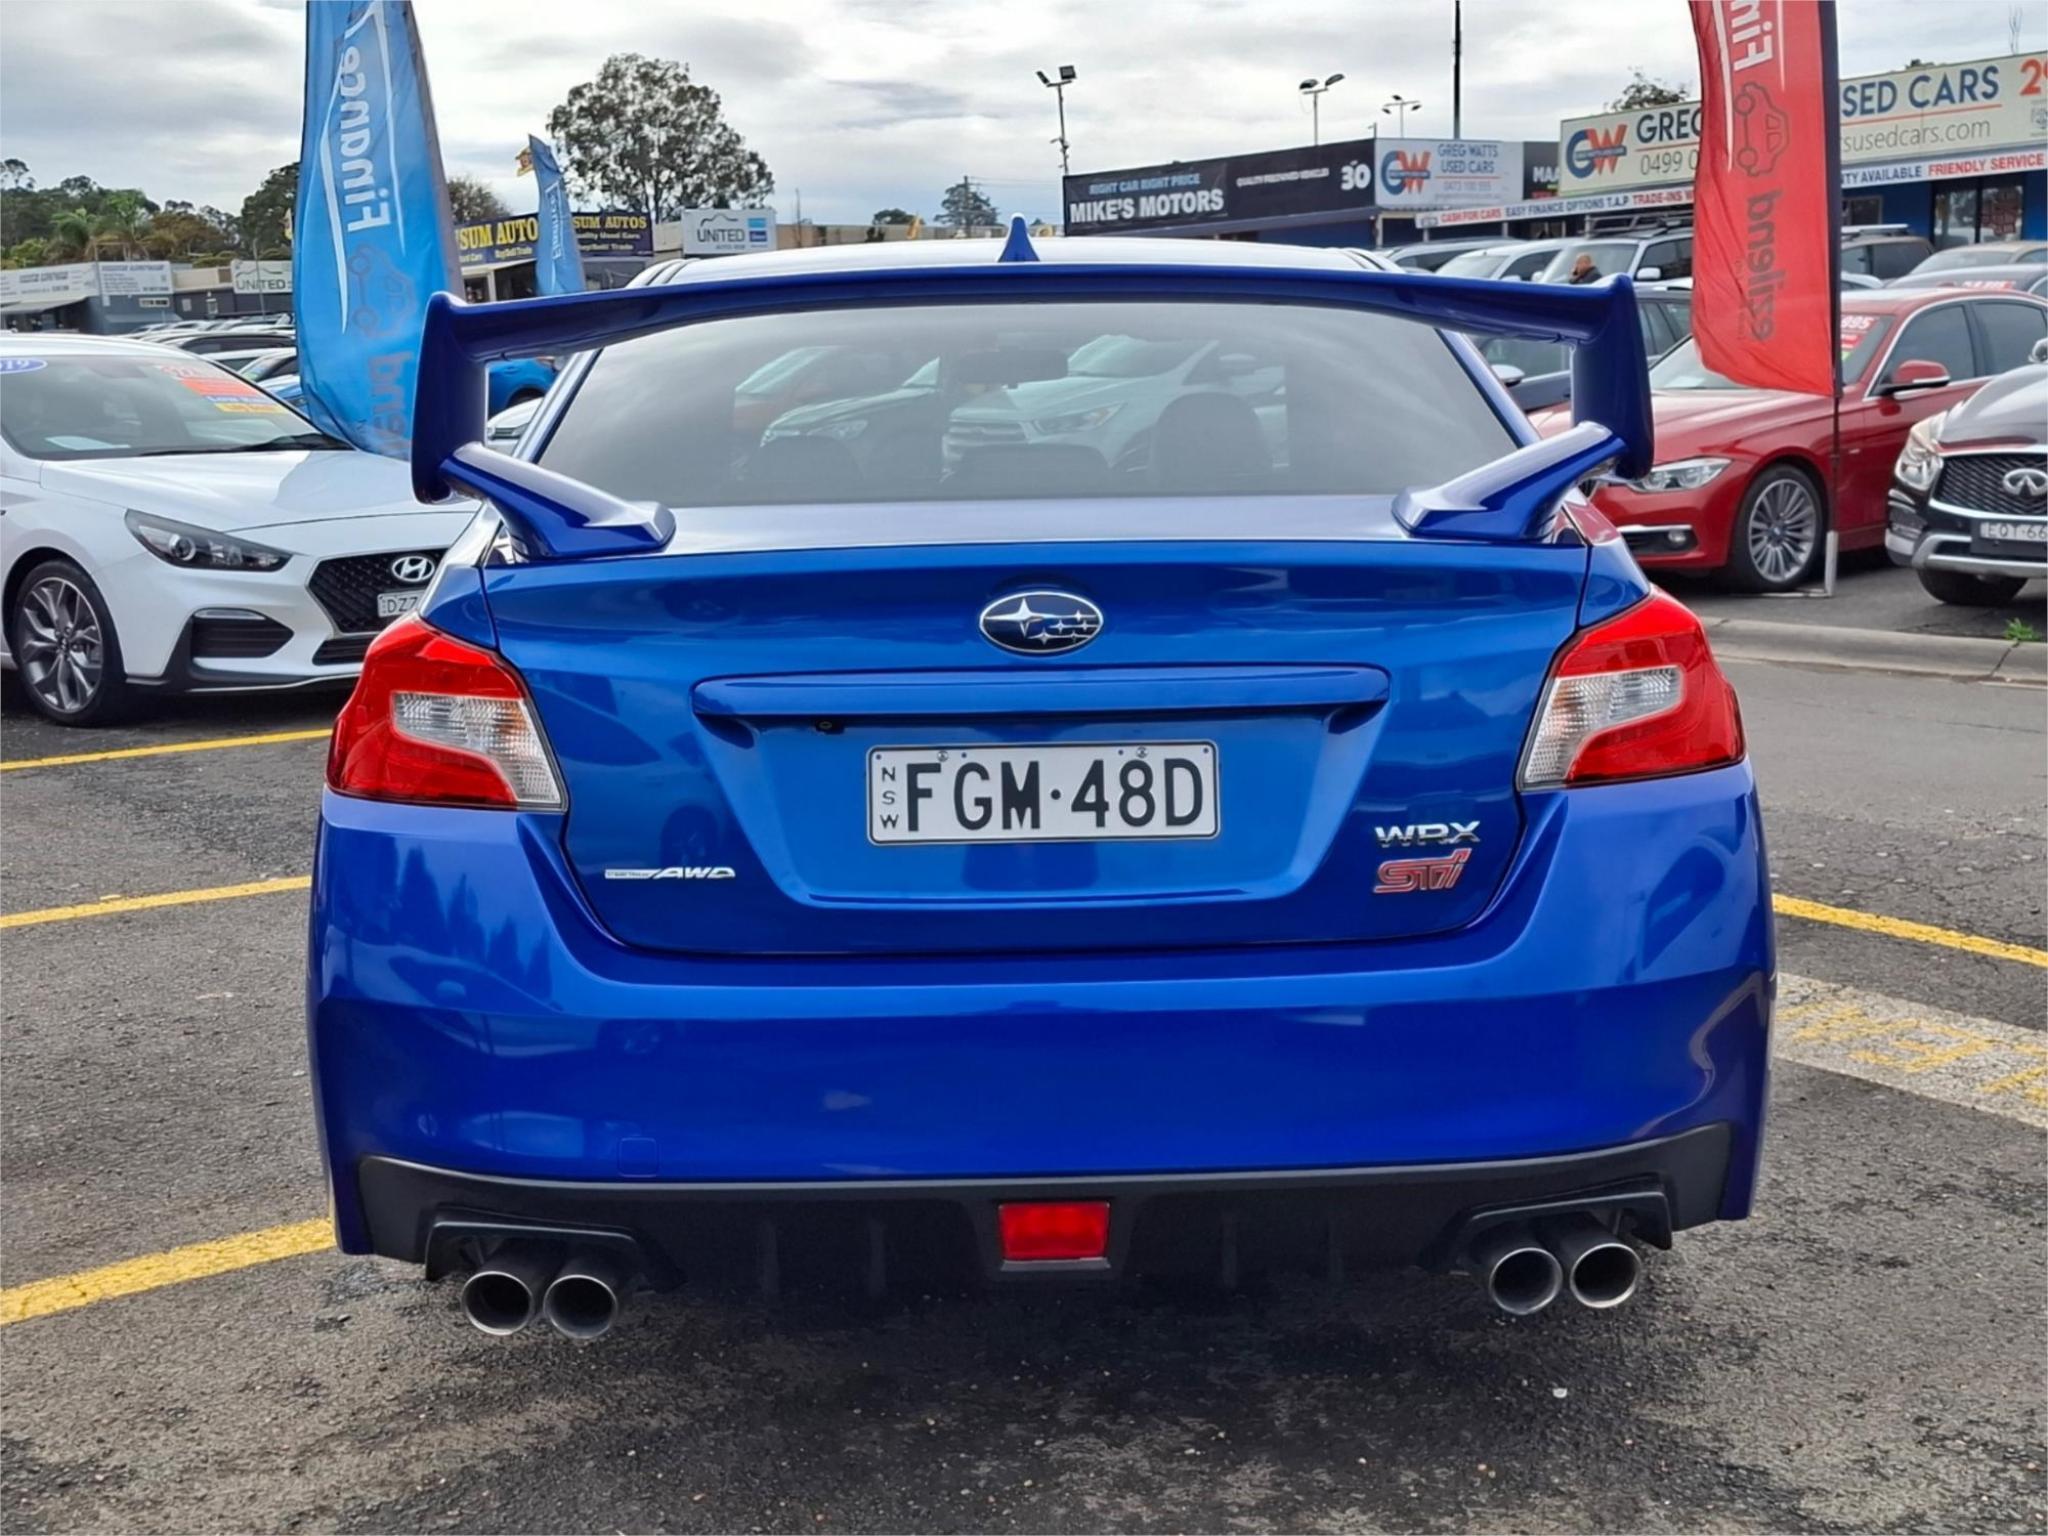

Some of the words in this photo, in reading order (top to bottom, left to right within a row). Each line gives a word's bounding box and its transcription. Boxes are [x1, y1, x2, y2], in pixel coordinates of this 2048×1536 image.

[1842, 80, 1897, 117] SED
[1908, 65, 1999, 108] CARS
[1842, 120, 1991, 153] susedcars.com
[1438, 143, 1466, 157] GREG
[1467, 144, 1499, 157] WATTS
[1441, 159, 1465, 174] USED
[1468, 160, 1495, 174] CARS
[1532, 166, 1559, 182] MAA
[1640, 151, 1683, 175] 0499
[1861, 165, 1922, 184] AVAILABLE
[1928, 159, 1987, 177] FRIENDLY
[1990, 152, 2044, 170] SERVICE
[1119, 180, 1139, 193] CAR
[1341, 164, 1371, 190] 30
[1070, 198, 1135, 223] MIKE'S
[1139, 189, 1224, 217] MOTORS
[1441, 213, 1463, 223] CASH
[1464, 211, 1479, 221] FOR
[1480, 208, 1501, 220] CARS
[1506, 206, 1527, 218] EASY
[1528, 203, 1564, 216] FINANCE
[1566, 199, 1604, 212] OPTIONS
[1632, 191, 1683, 205] TRADE-INS
[459, 223, 493, 250] SUM
[496, 217, 539, 245] AUTO
[573, 216, 601, 230] SUM
[604, 216, 647, 230] AUTOS
[697, 228, 745, 243] UNITED
[236, 279, 286, 290] UNITED
[1374, 821, 1480, 848] WRX
[653, 866, 736, 879] AWD
